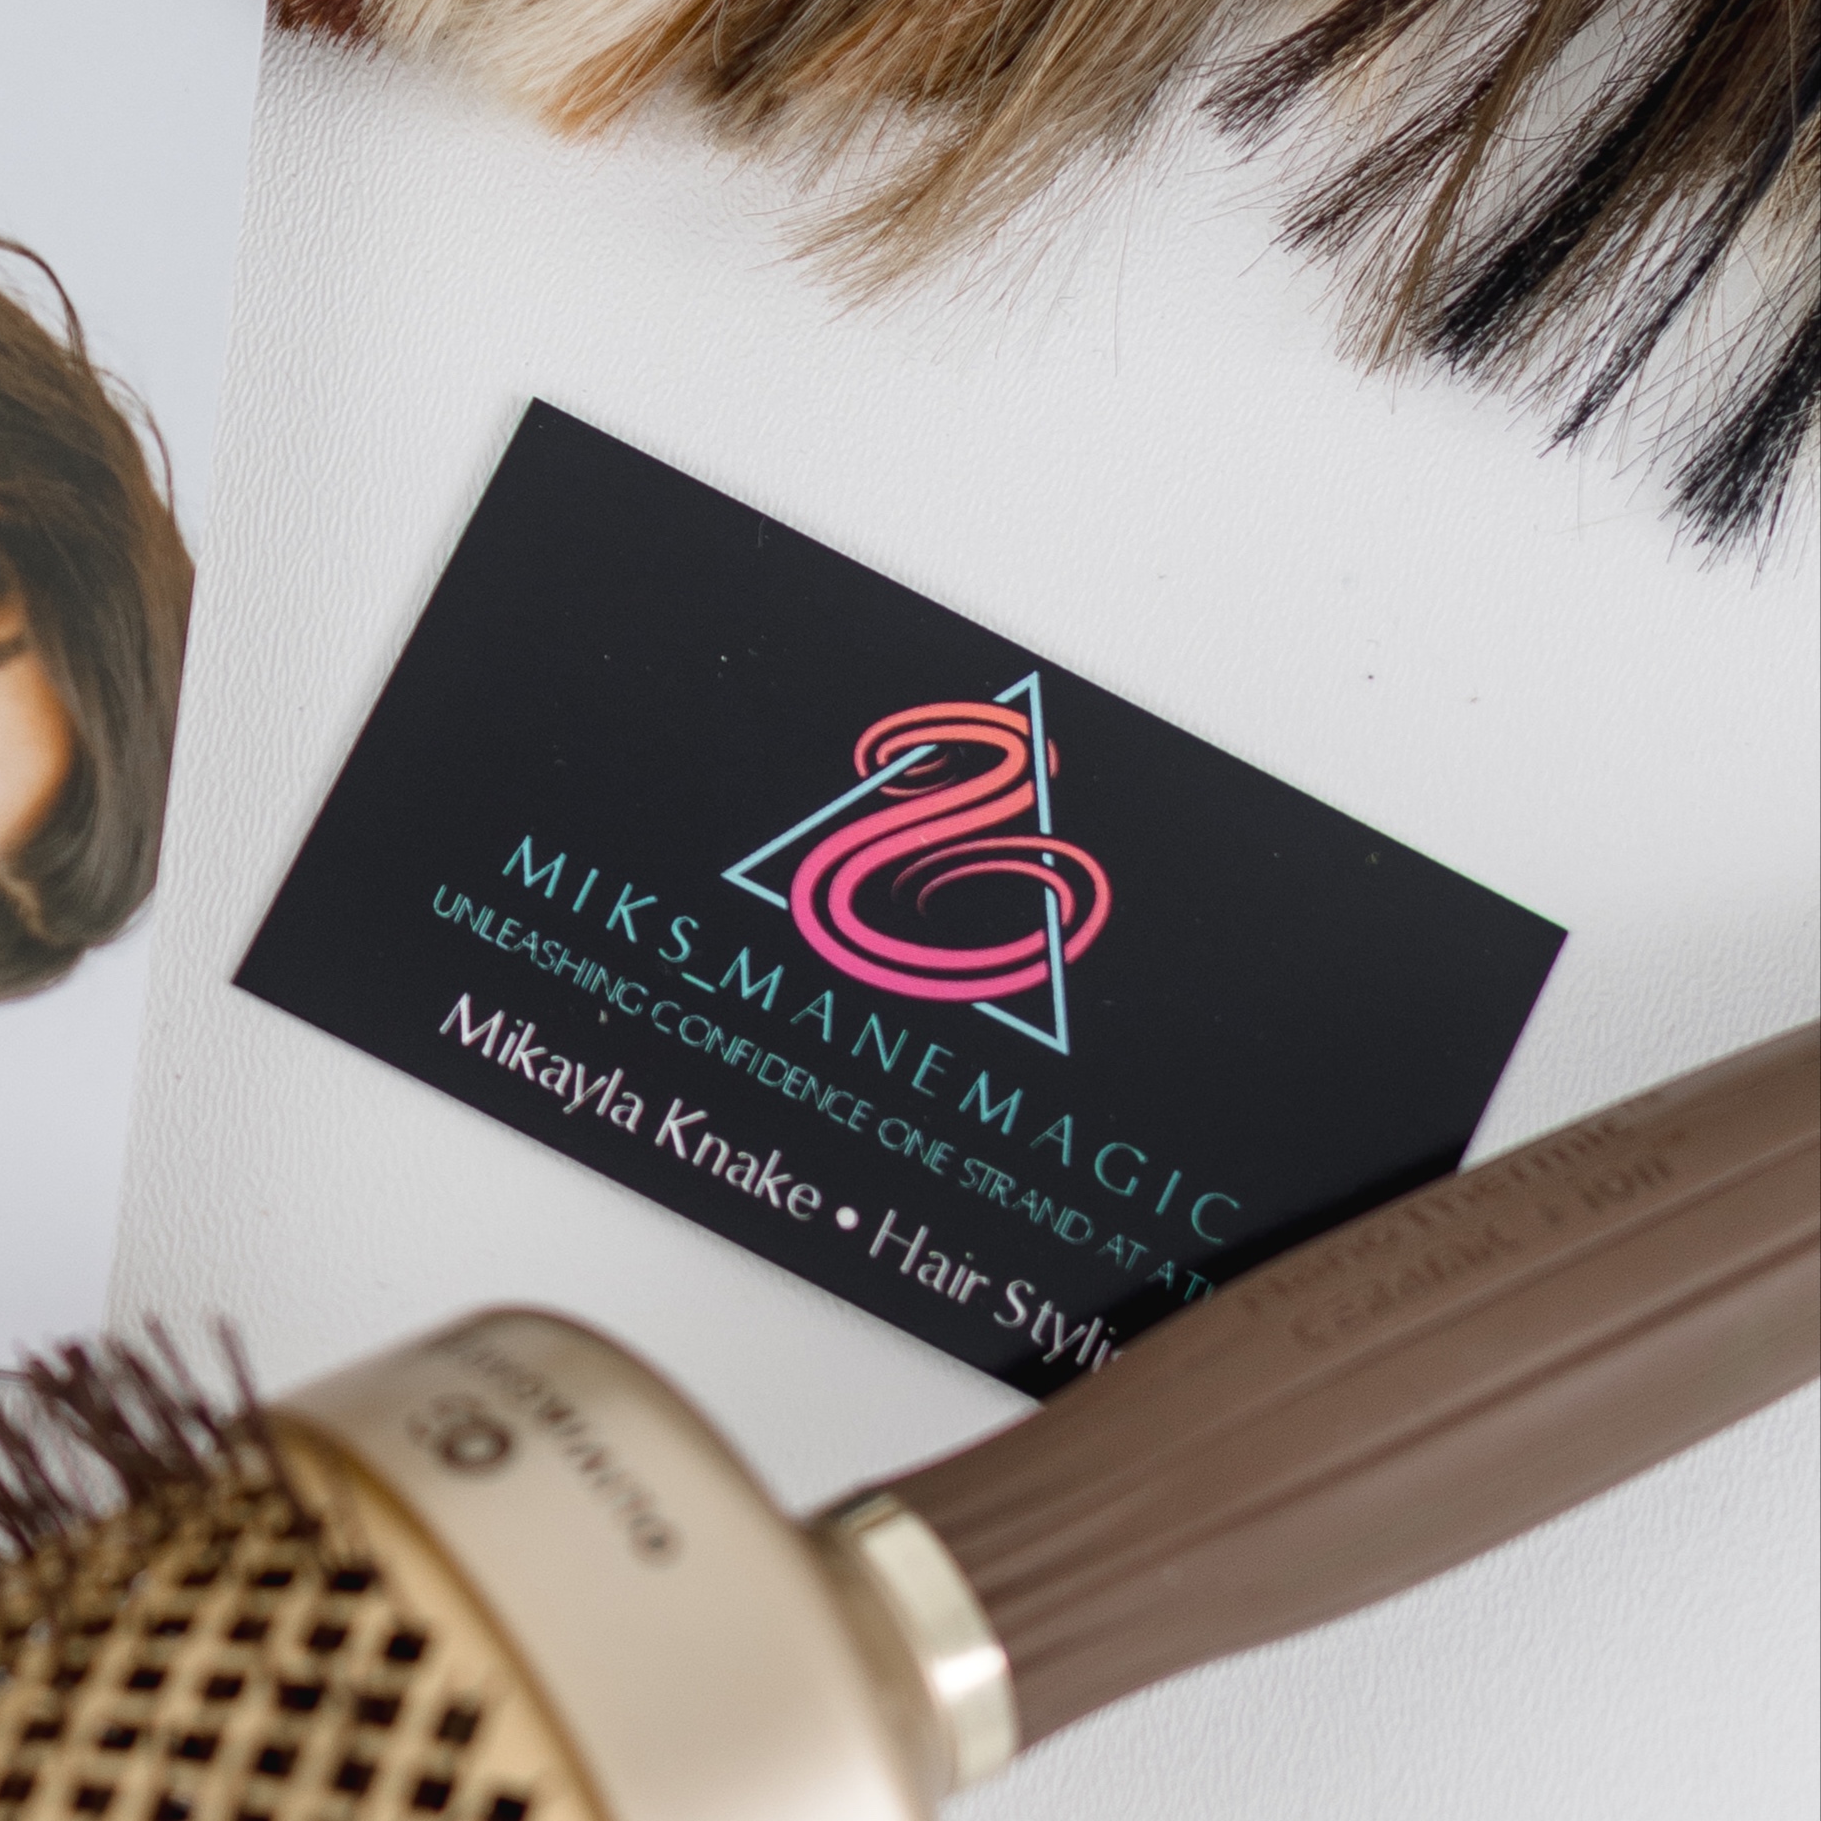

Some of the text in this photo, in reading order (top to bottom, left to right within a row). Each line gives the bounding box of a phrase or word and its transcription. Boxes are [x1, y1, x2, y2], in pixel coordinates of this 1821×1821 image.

[432, 884, 649, 1015] UNLEASHING
[650, 1000, 873, 1132] CONFIDENCE
[877, 1117, 954, 1175] ONE
[959, 1157, 1093, 1243] STRAND
[1106, 1233, 1148, 1269] AT
[1152, 1259, 1176, 1288] A
[438, 992, 644, 1133] Mikayla
[654, 1097, 822, 1219] Knake
[868, 1208, 990, 1304] Hair
[992, 1278, 1125, 1374] Styli
